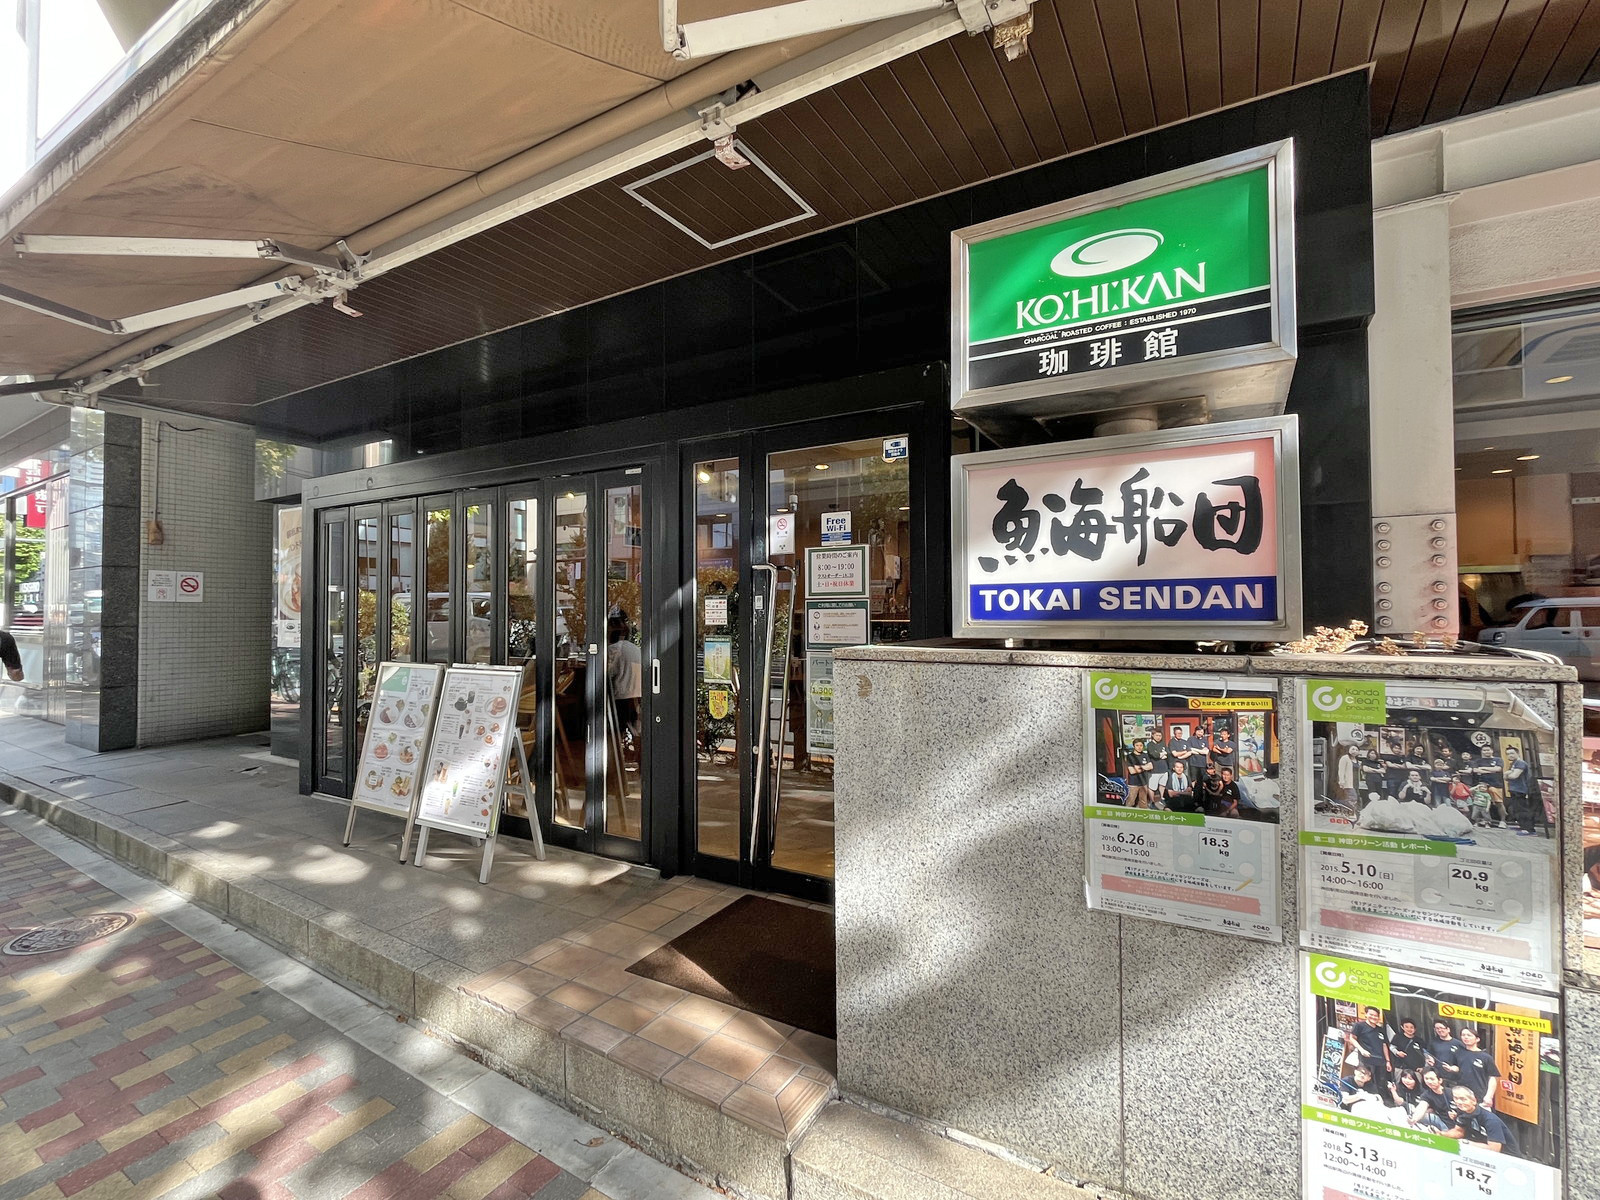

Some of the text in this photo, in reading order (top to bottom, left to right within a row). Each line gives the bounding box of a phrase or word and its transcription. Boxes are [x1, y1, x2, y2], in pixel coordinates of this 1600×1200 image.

[1023, 333, 1059, 345] CHARCOAL
[1061, 327, 1093, 338] ROASTED
[1095, 322, 1122, 331] COFFEE
[1129, 312, 1177, 325] ESTABLISHED
[1179, 308, 1197, 316] 1970
[826, 517, 846, 525] Free
[977, 467, 1264, 573] 魚海船団
[816, 551, 859, 560] 営業時間のご案内
[979, 583, 1264, 612] TOKAI SENDAN
[1345, 688, 1380, 696] Kanda
[1117, 832, 1145, 846] 6.26
[1201, 836, 1230, 848] 18.3
[1338, 837, 1398, 849] 神田クリーン活動
[1401, 843, 1432, 851] レポート
[1219, 849, 1230, 857] kg
[1341, 861, 1377, 877] 5.10
[1451, 868, 1489, 882] 20.9
[1475, 883, 1489, 892] kg
[1349, 967, 1384, 980] Kanda
[1404, 1131, 1436, 1145] レポート
[1344, 1141, 1379, 1162] 5.13
[1455, 1166, 1492, 1184] 18.7
[1478, 1184, 1492, 1196] kg
